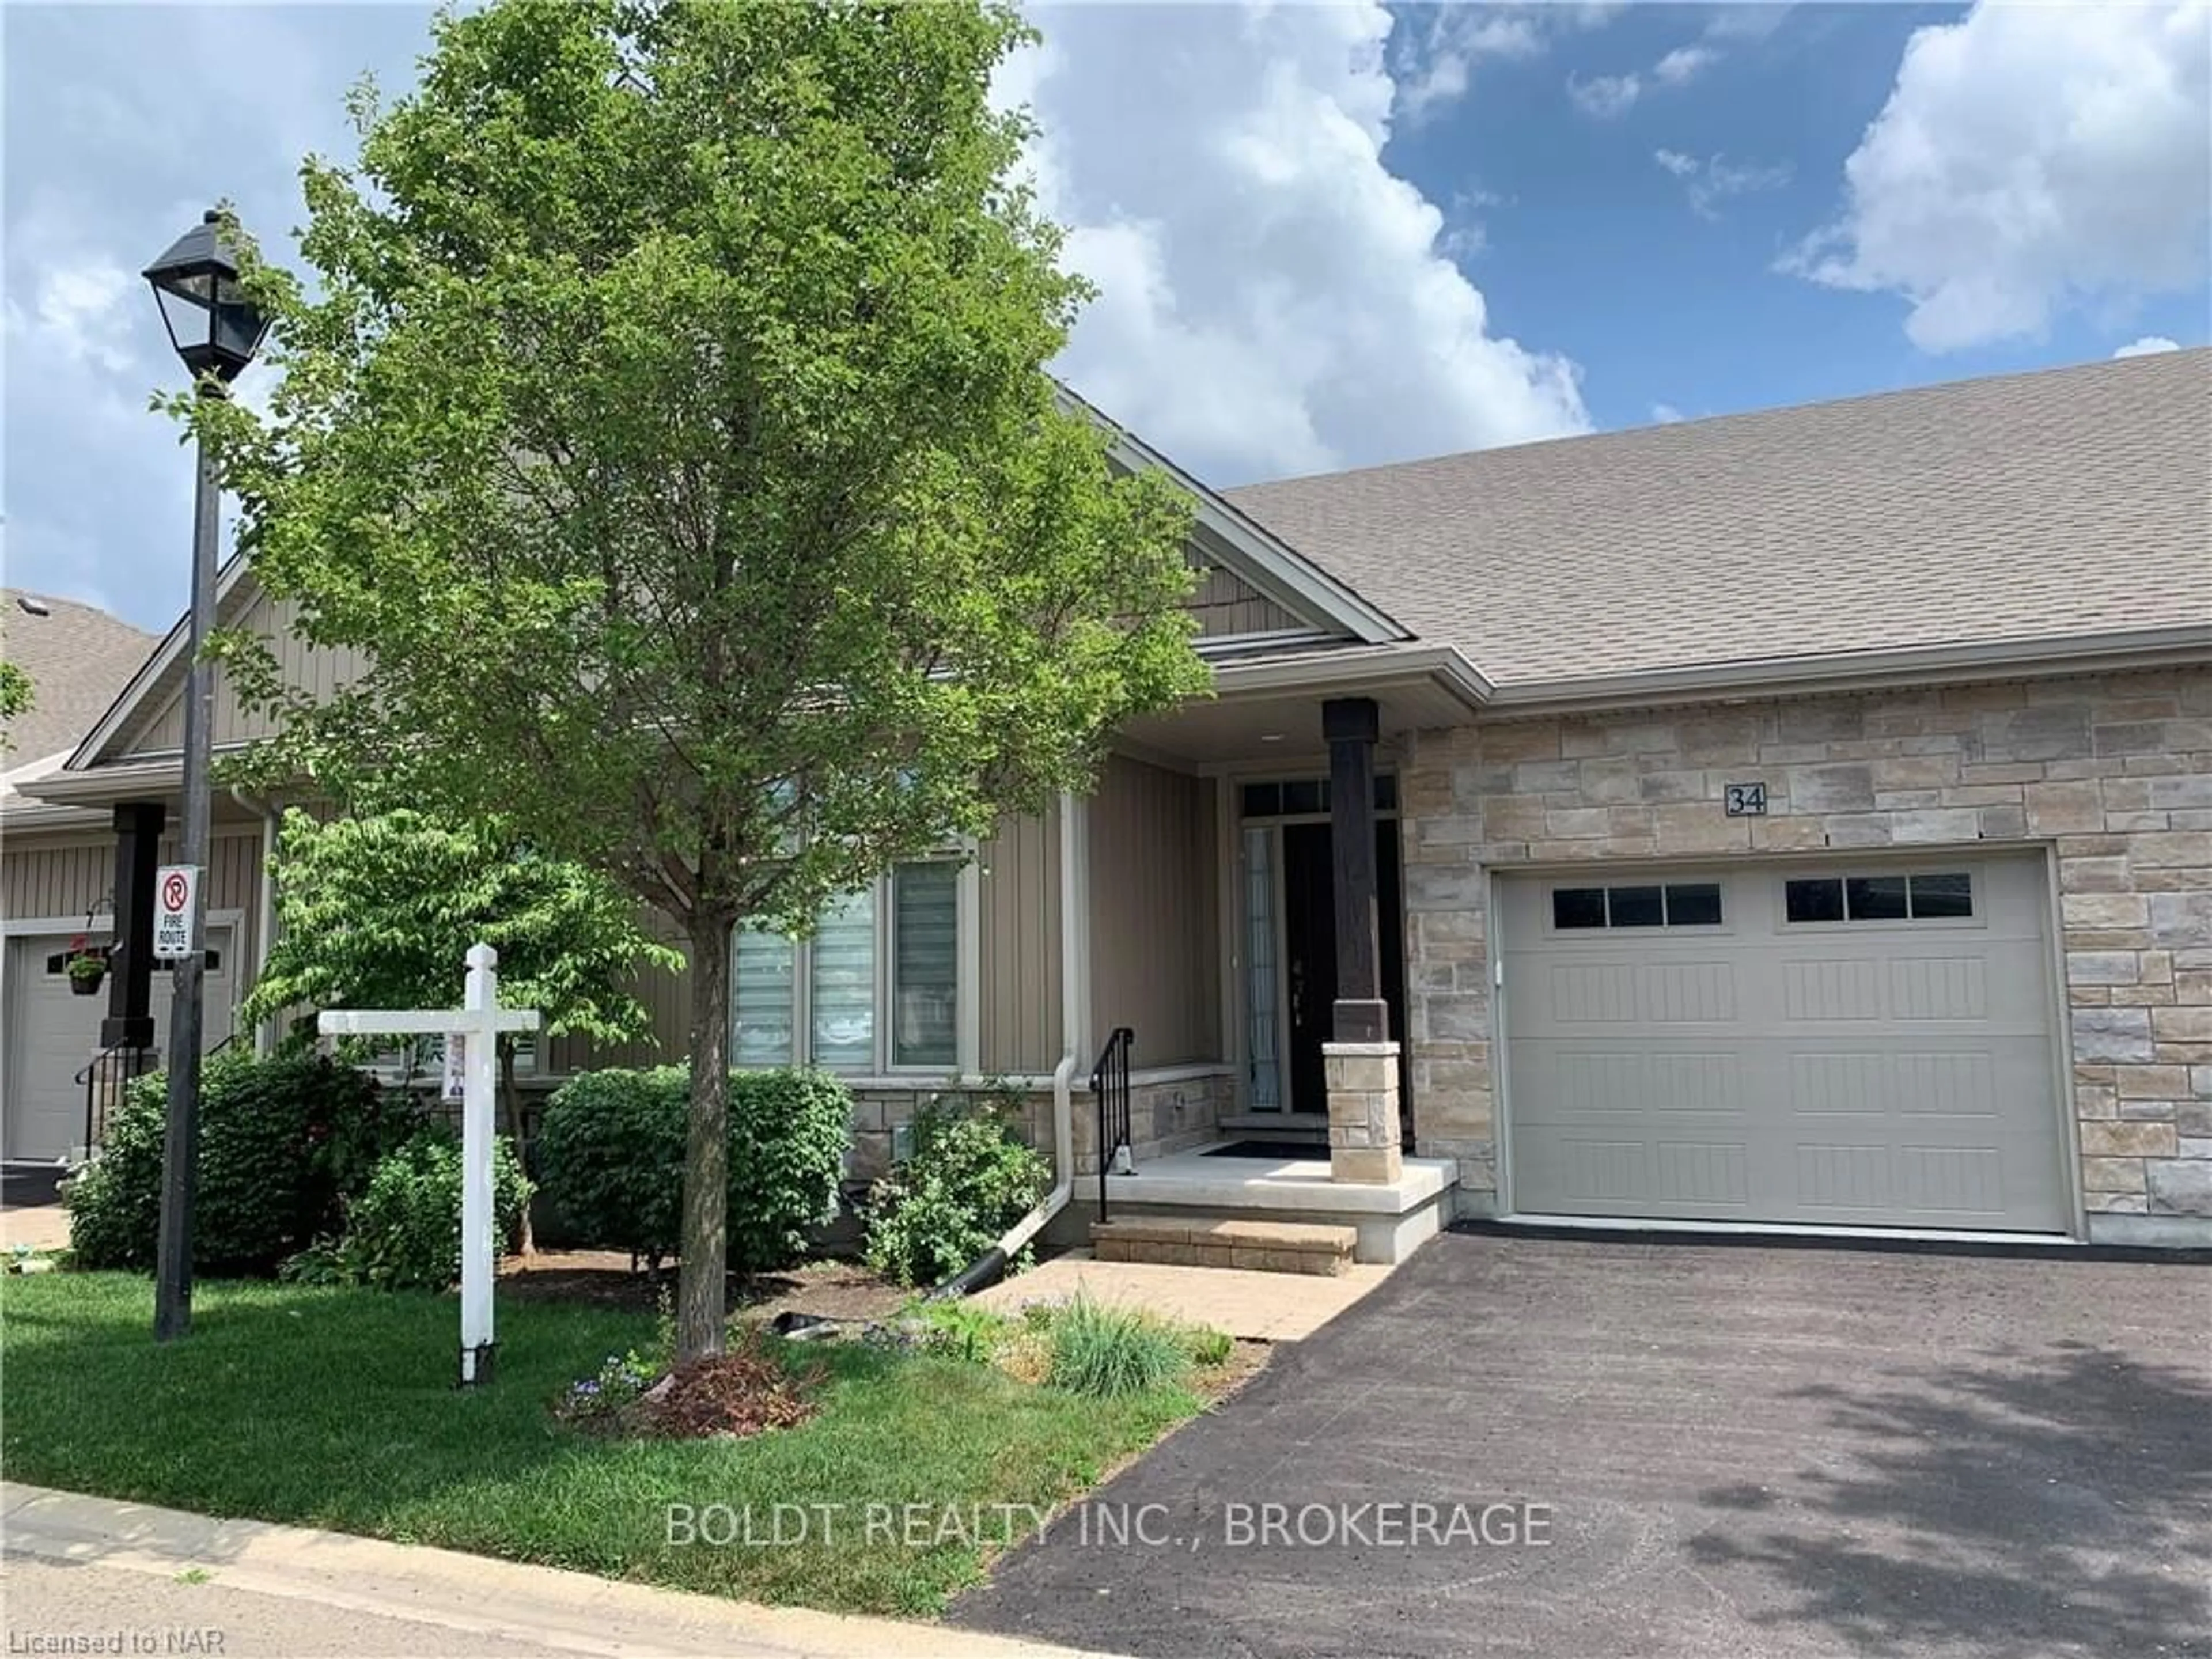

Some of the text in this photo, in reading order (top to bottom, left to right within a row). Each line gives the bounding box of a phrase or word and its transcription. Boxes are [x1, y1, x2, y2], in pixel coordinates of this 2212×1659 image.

[1730, 787, 1764, 813] 34
[164, 914, 183, 928] FIRE
[159, 930, 185, 944] ROUTE
